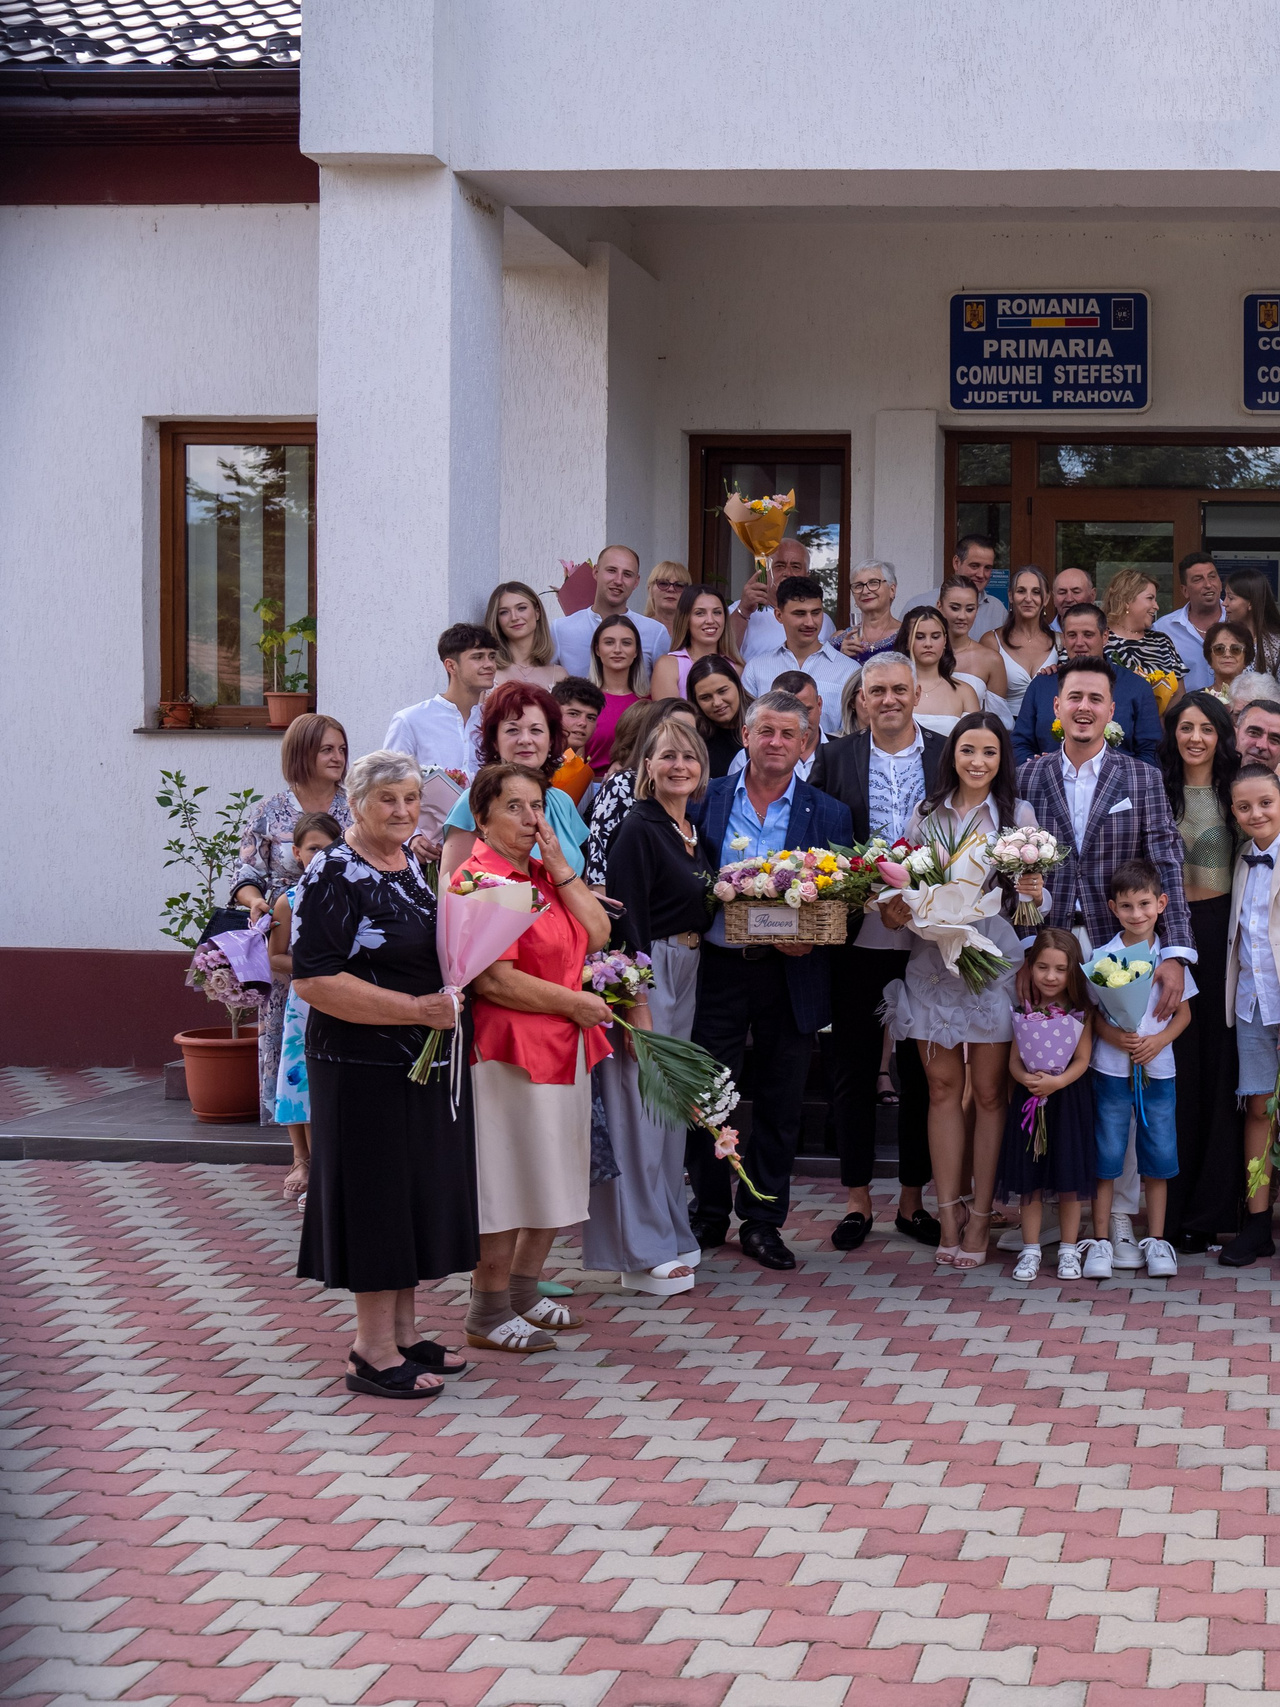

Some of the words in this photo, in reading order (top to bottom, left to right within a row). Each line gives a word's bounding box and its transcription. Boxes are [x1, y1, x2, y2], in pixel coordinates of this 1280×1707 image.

[997, 298, 1101, 315] ROMANIA
[983, 338, 1114, 359] PRIMARIA
[956, 365, 1043, 385] COMUNEI
[1054, 364, 1142, 384] STEFESTI
[963, 391, 1042, 404] JUDETUL
[1052, 390, 1134, 403] PRAHOVA
[754, 913, 793, 928] Flowers
